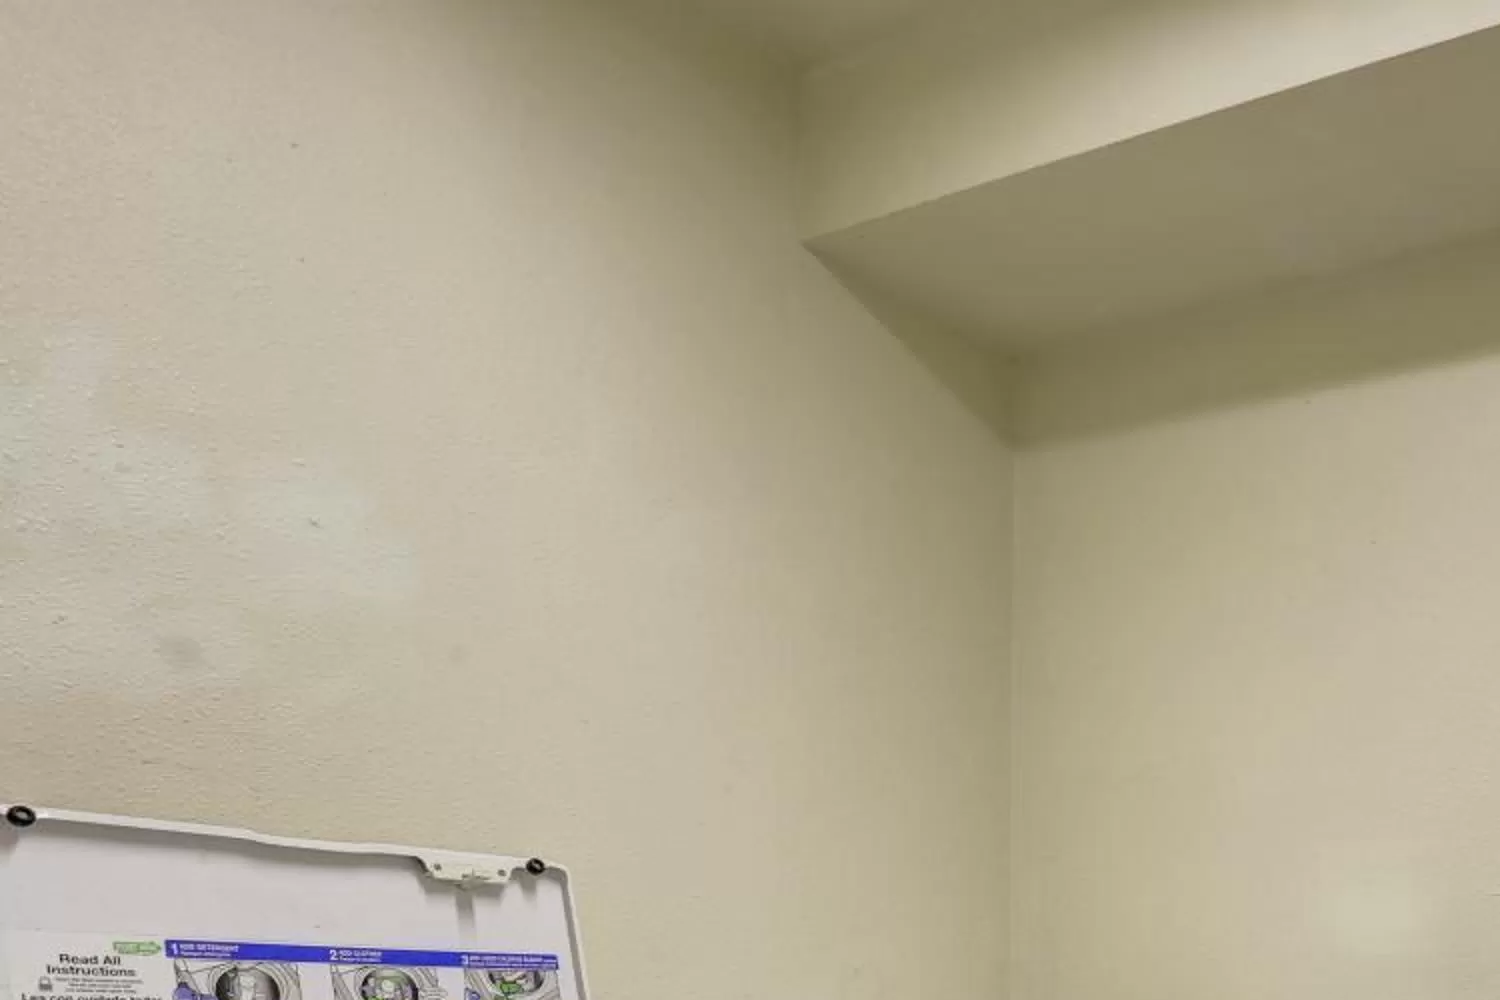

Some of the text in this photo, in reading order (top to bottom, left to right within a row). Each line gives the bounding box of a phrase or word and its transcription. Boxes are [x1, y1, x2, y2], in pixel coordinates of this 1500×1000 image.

[171, 941, 179, 955] 1
[59, 953, 122, 966] Read All
[329, 949, 338, 961] 2
[460, 954, 469, 966] 3
[46, 964, 137, 977] Instructions
